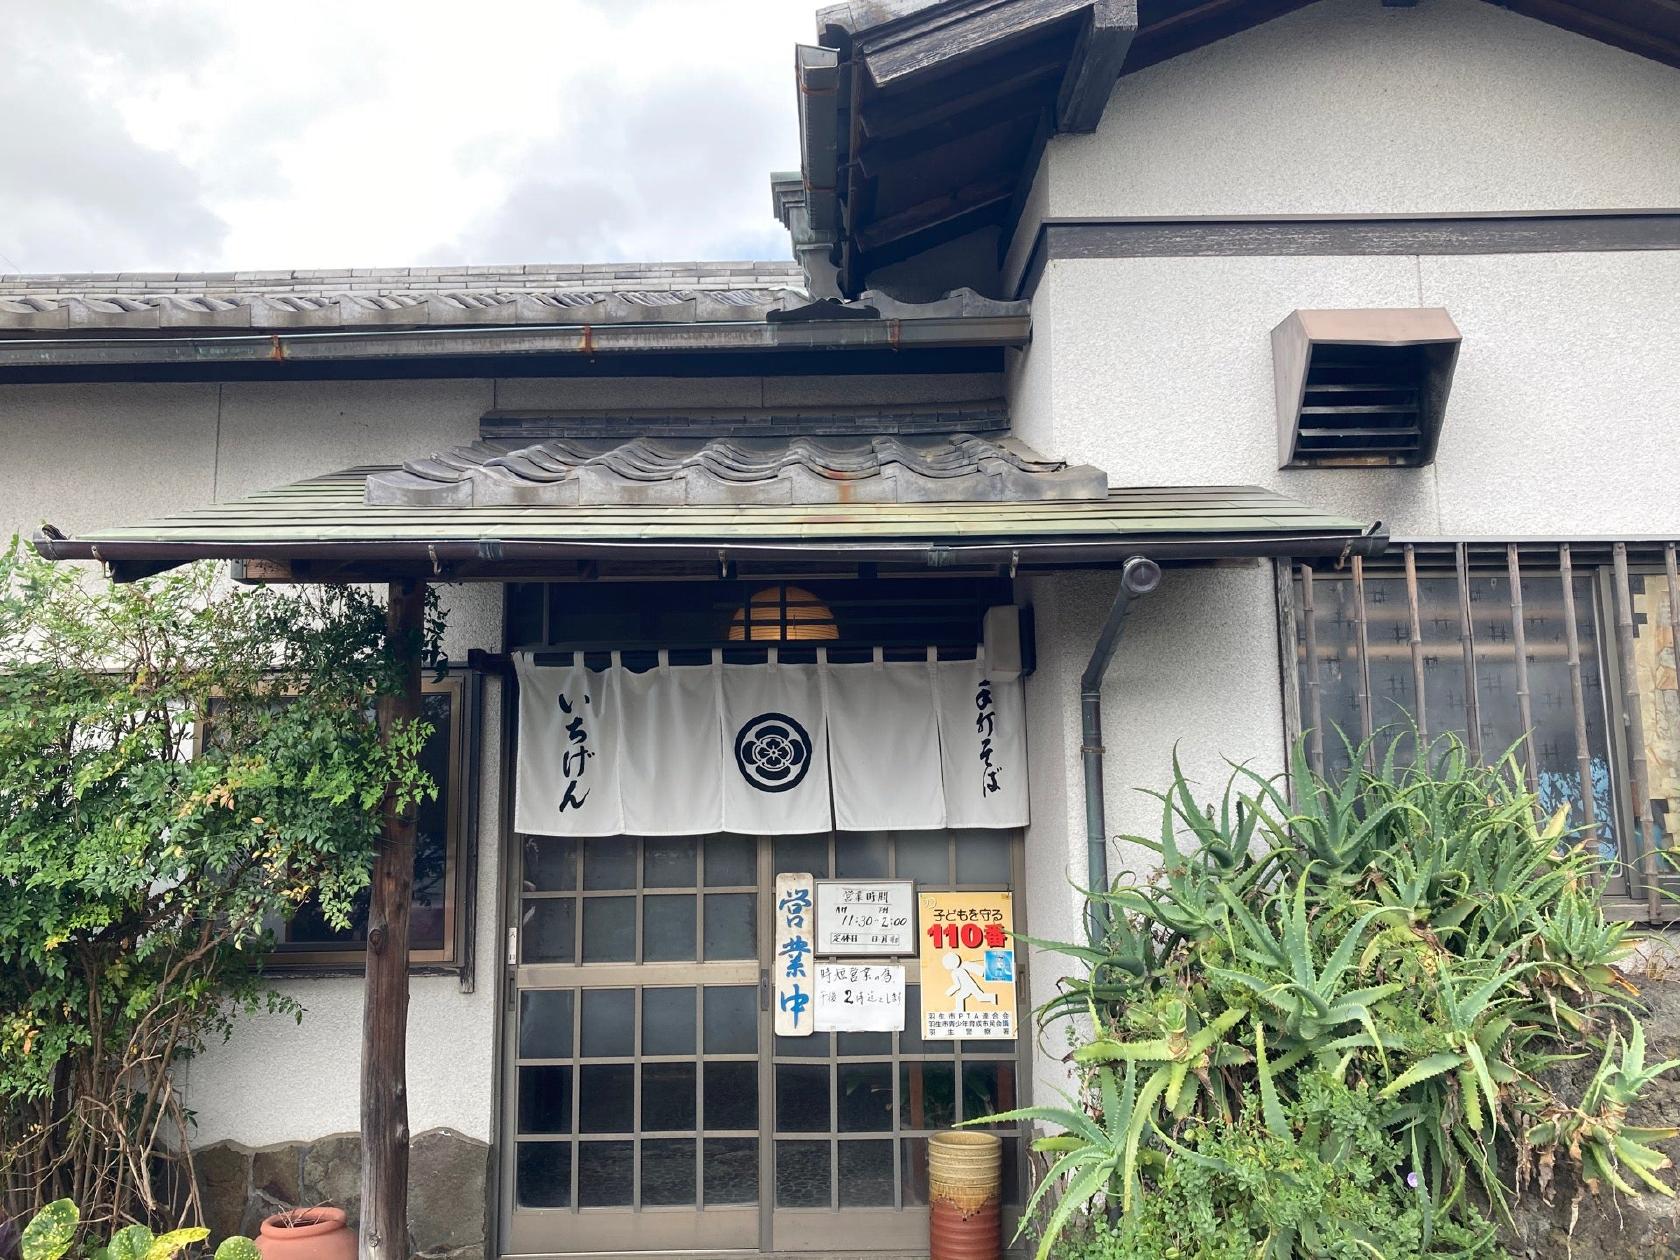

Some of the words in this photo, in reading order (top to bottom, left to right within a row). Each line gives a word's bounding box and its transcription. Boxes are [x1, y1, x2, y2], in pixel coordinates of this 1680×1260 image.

[558, 692, 597, 813] いちげん
[842, 889, 889, 904] 営業時間
[933, 908, 1003, 922] 子どもを守る
[927, 922, 1008, 949] 110番
[778, 888, 812, 1030] 営業中
